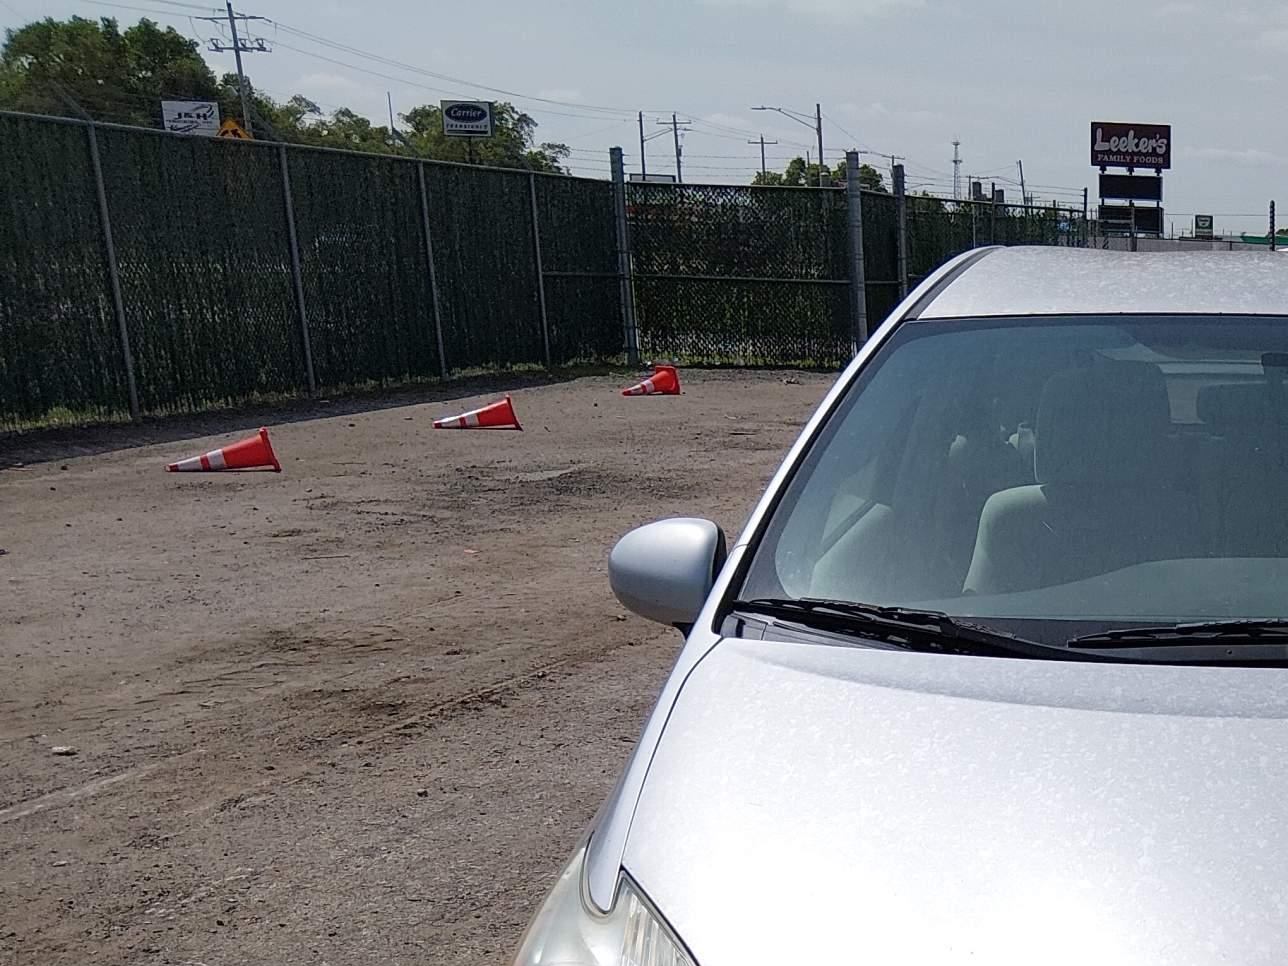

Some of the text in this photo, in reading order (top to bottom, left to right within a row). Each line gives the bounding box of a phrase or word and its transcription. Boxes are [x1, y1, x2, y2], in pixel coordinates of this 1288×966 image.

[450, 107, 482, 118] Carrier
[1094, 127, 1168, 154] Leeker's
[1097, 154, 1164, 164] FAMILY FOODS
